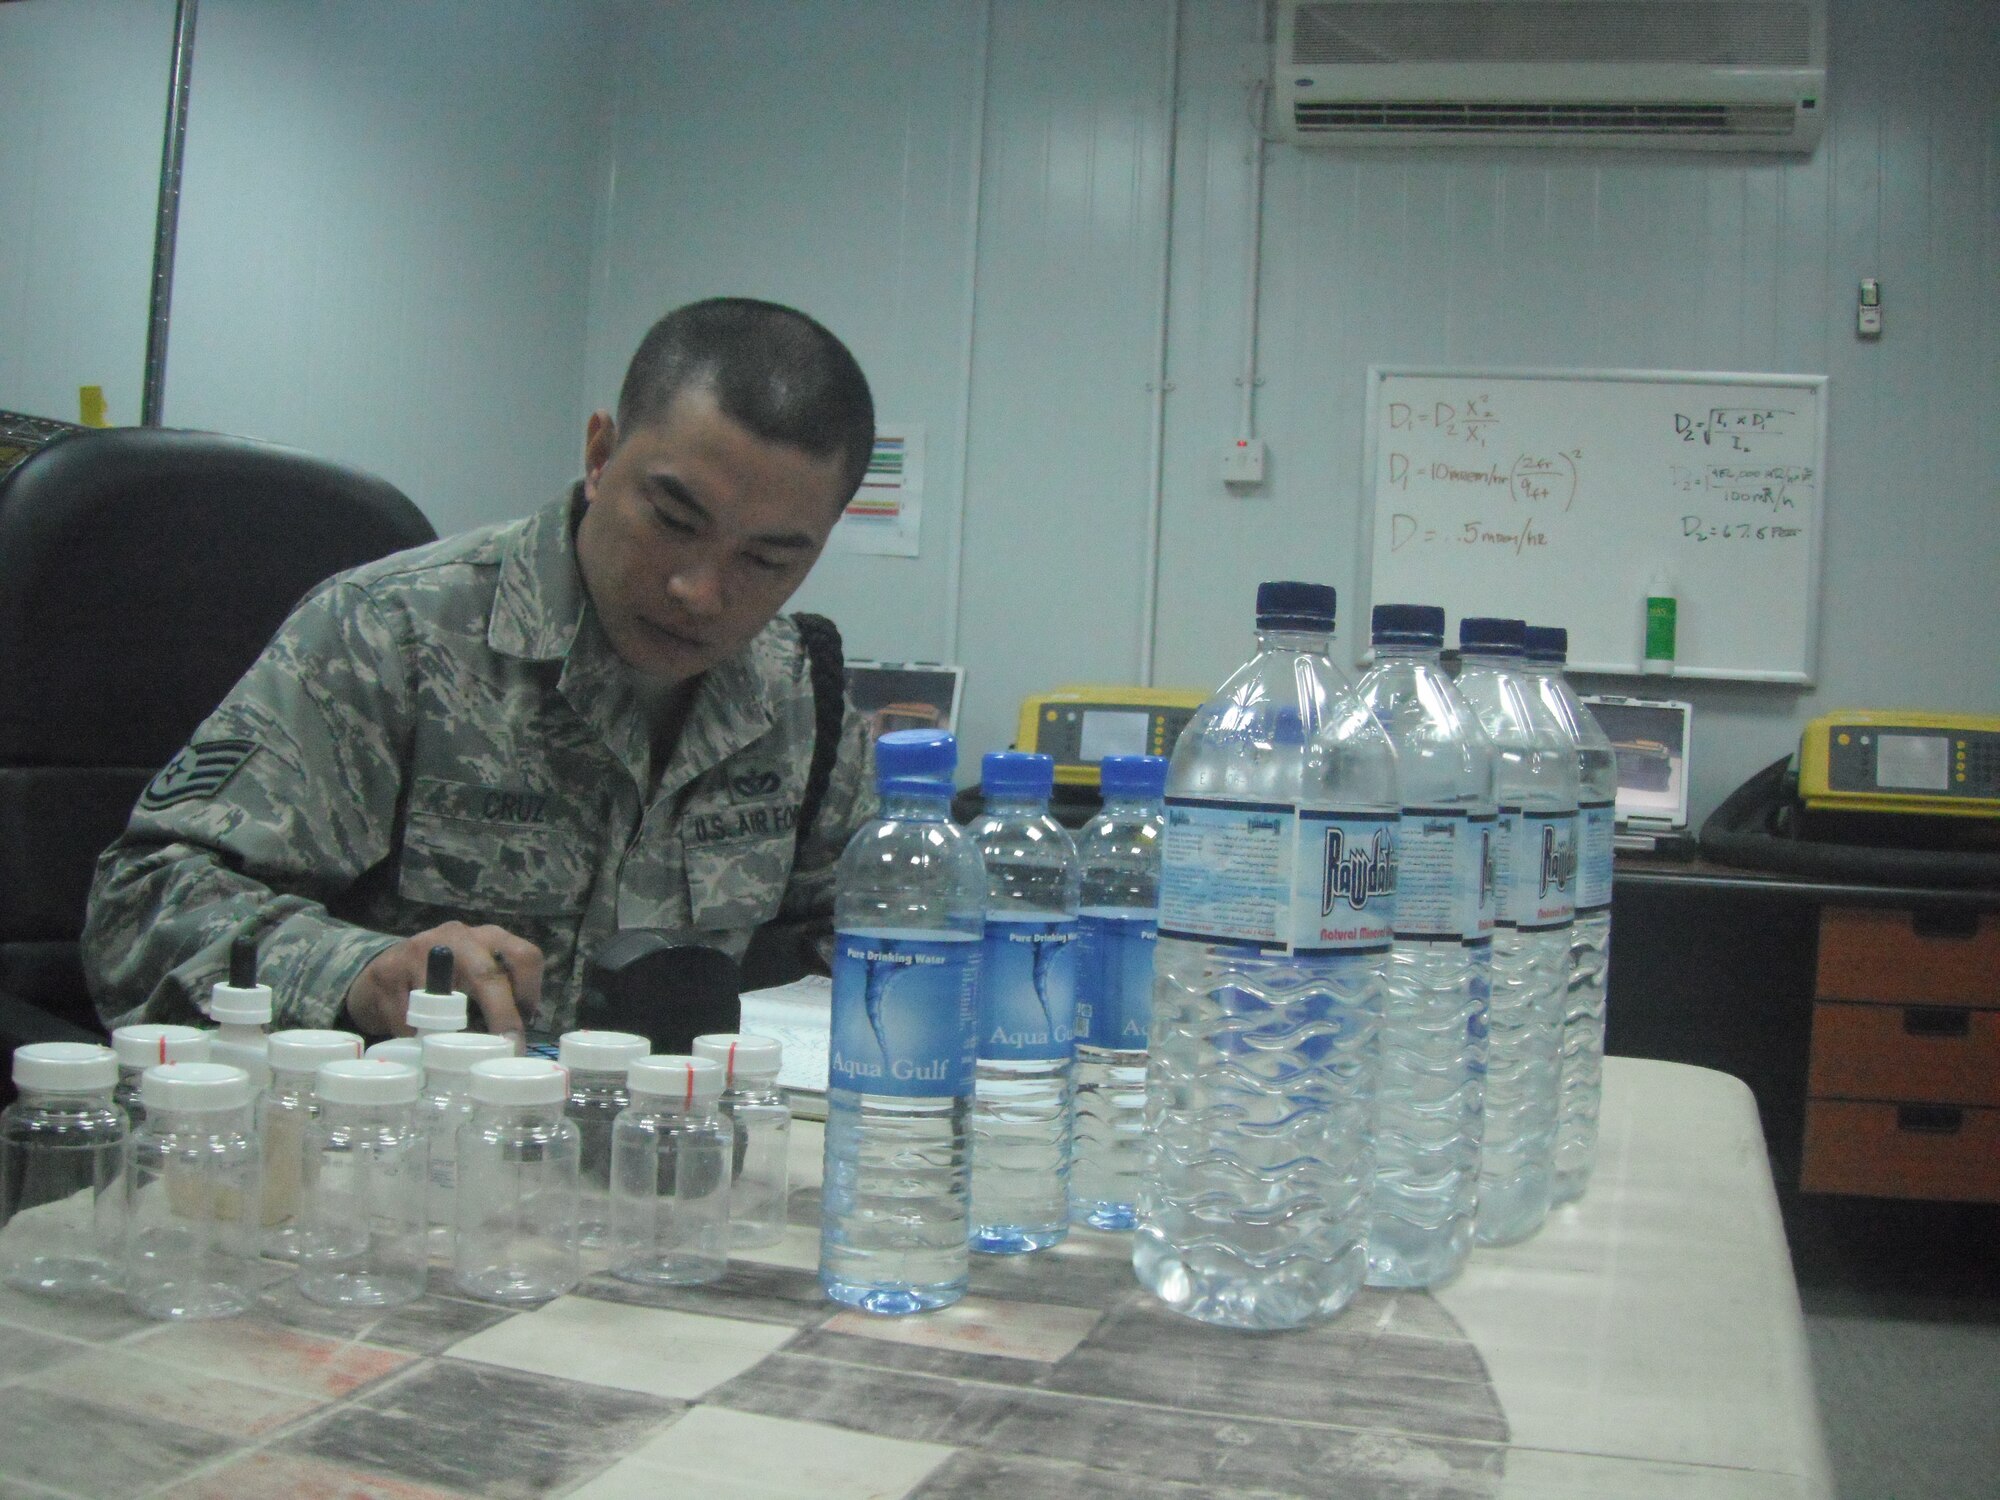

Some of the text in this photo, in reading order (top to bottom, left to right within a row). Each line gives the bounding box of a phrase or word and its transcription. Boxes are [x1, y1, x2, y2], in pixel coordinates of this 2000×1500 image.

[483, 791, 546, 823] CRUZ
[738, 809, 768, 836] AIR
[1009, 933, 1031, 943] Pure
[1033, 933, 1067, 944] Drinking
[1320, 928, 1356, 941] Natural
[847, 947, 946, 965] Pure Drinking Water
[989, 1026, 1048, 1049] Aqua
[832, 1050, 949, 1081] Aqua Gulf
